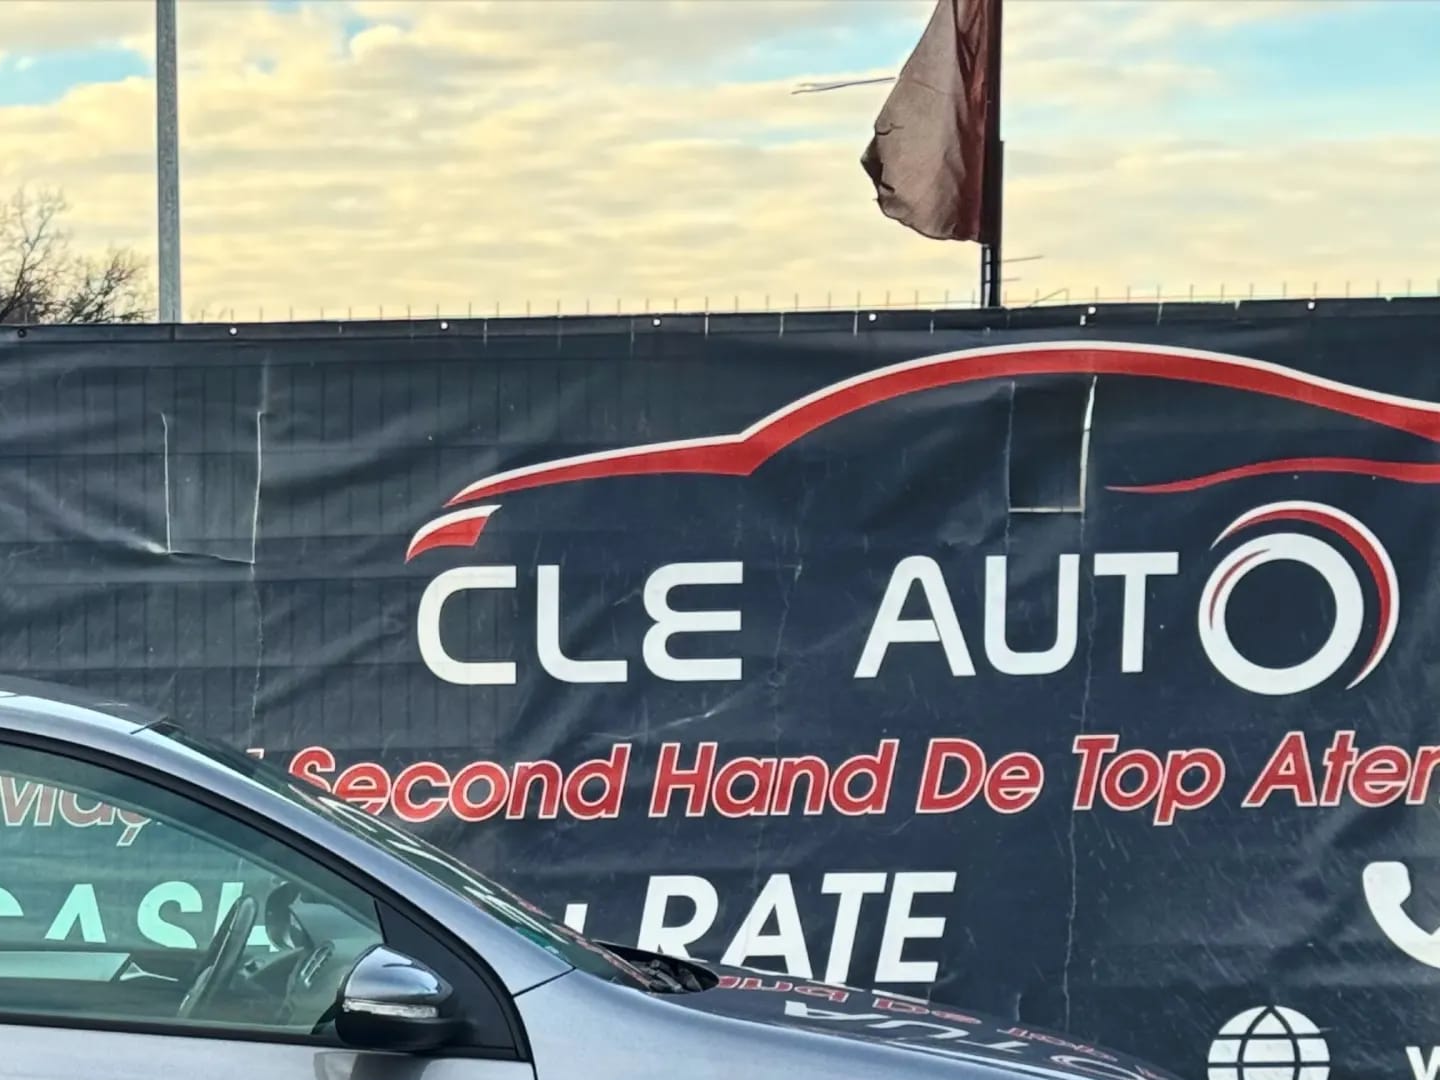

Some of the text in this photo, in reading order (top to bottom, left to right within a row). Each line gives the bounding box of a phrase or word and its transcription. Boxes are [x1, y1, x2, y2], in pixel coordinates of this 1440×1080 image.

[416, 532, 1365, 696] CLE AUTO
[288, 743, 632, 823] Second
[648, 739, 899, 819] Hand
[915, 738, 1045, 815] De
[1073, 734, 1225, 827] Top
[636, 871, 957, 984] RATE
